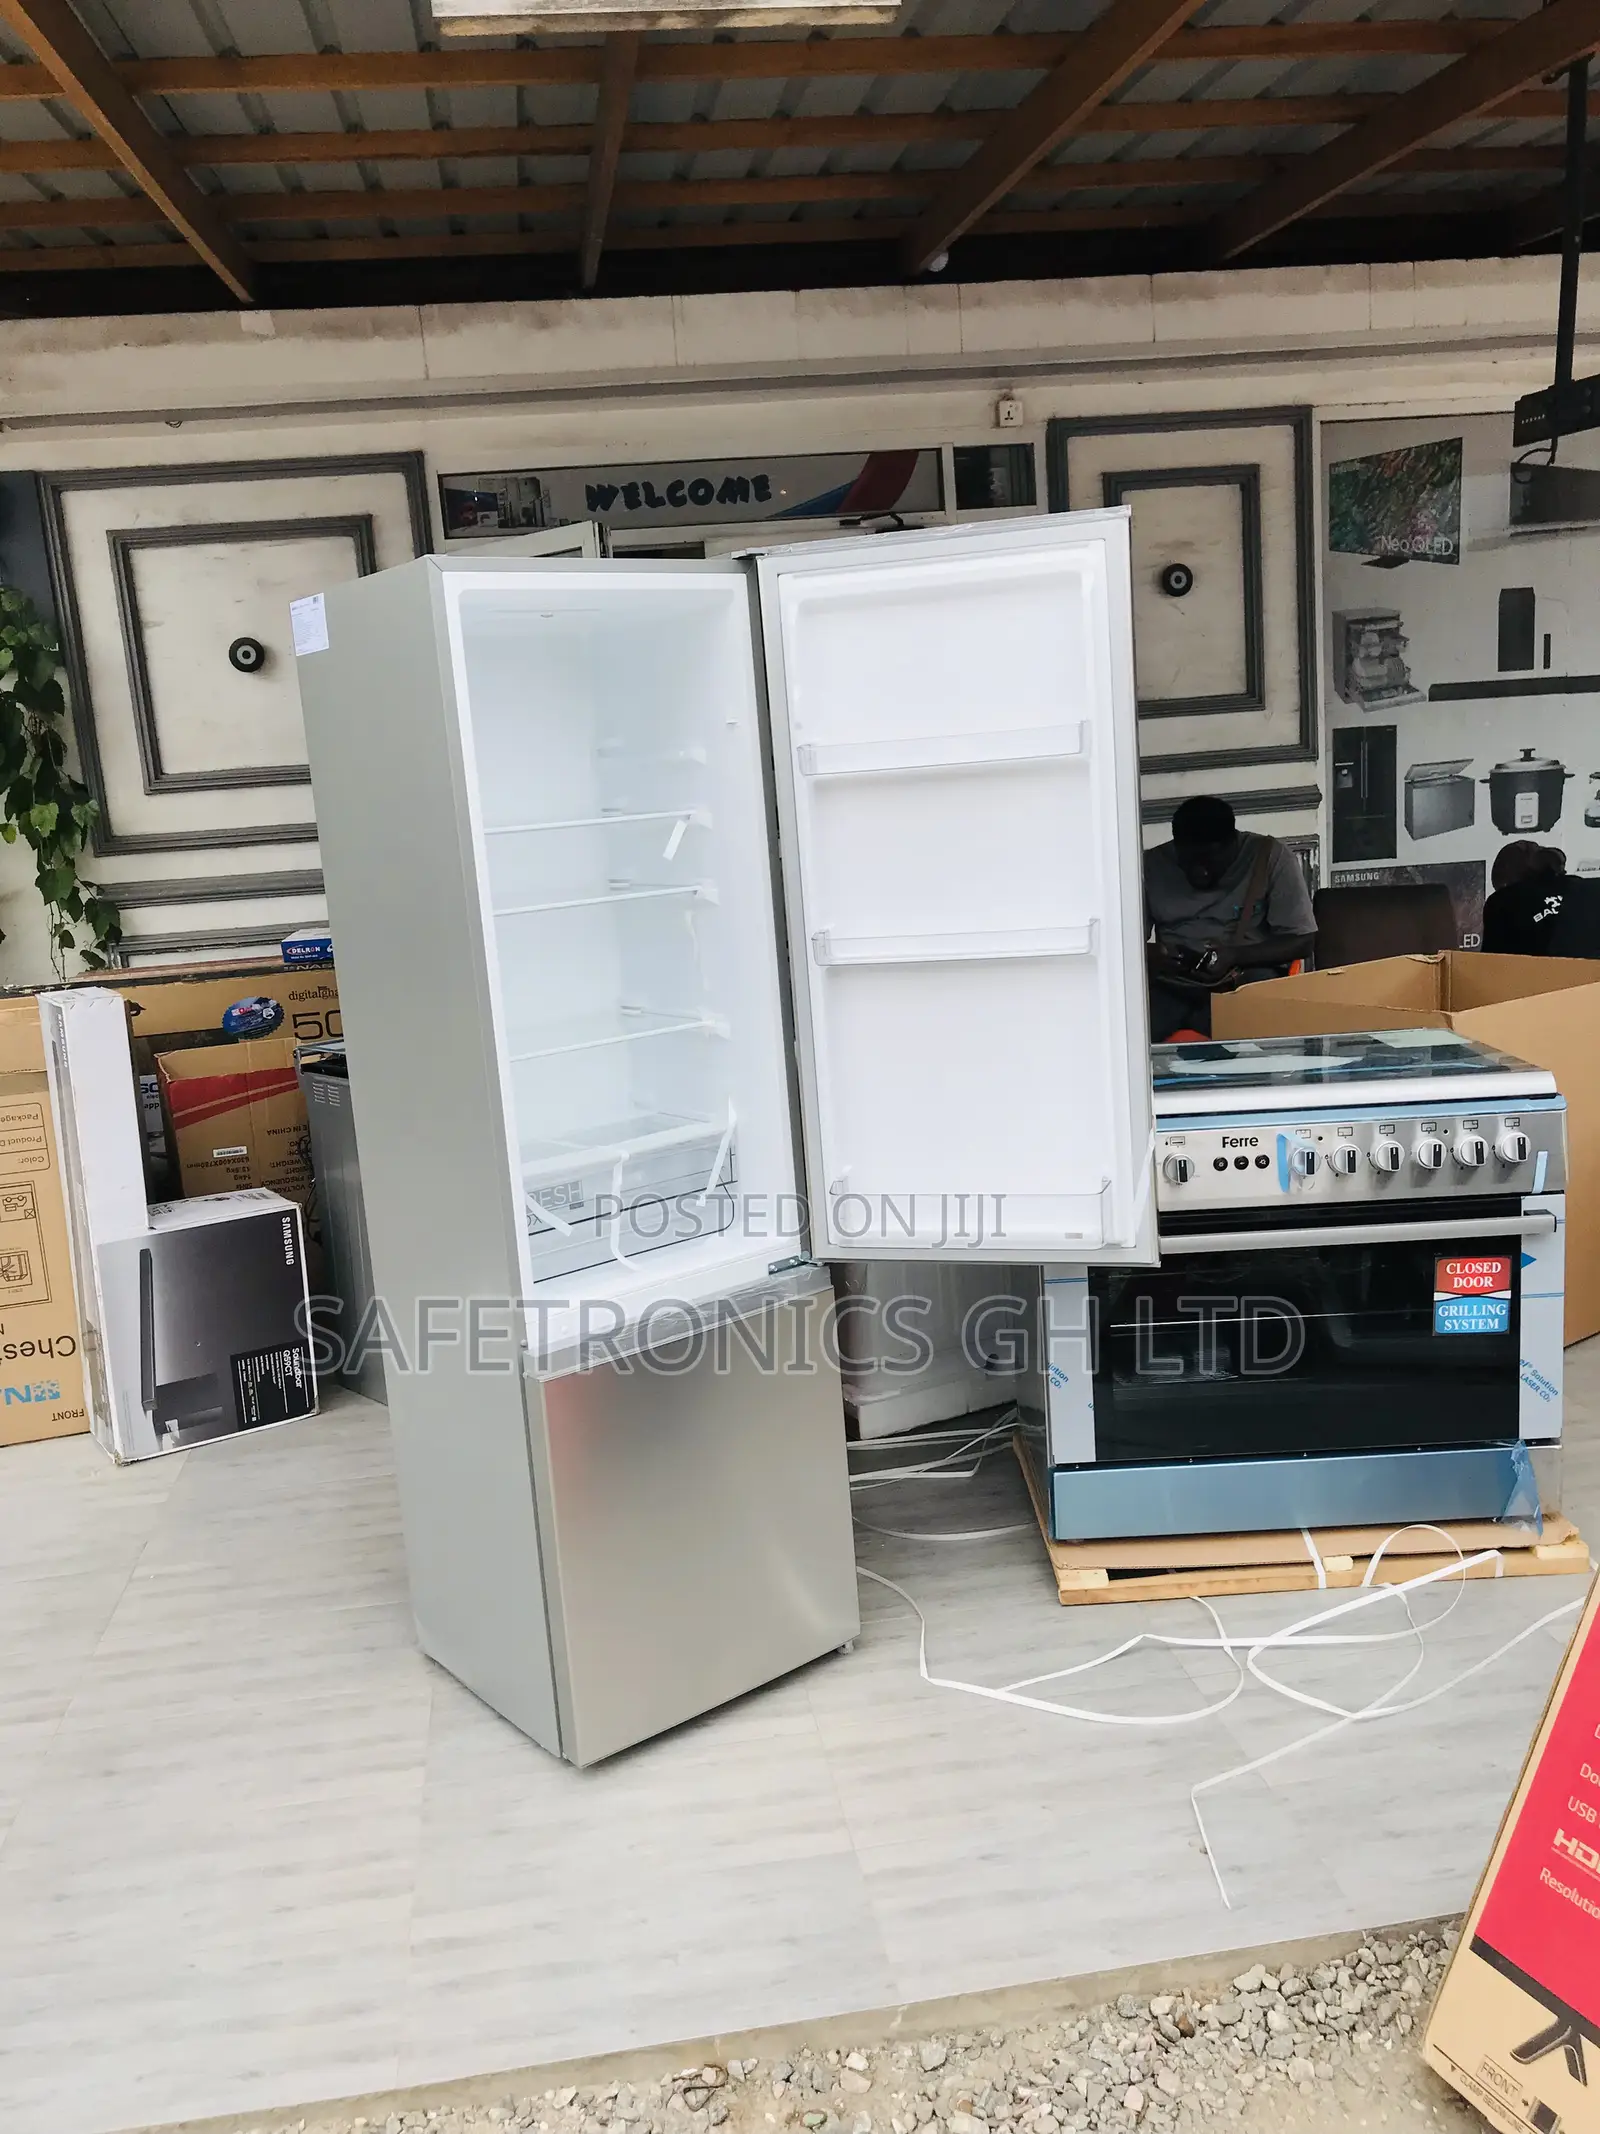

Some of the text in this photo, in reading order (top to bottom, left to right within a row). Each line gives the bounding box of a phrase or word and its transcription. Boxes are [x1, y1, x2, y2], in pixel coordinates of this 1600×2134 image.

[585, 474, 772, 512] WELCOME
[1334, 872, 1381, 883] SAMSUNG
[291, 945, 321, 955] DELRON
[57, 1013, 68, 1068] SAMSUNG
[0, 1113, 39, 1122] Package
[266, 1127, 292, 1136] CHINA
[8, 1136, 42, 1146] Product
[1221, 1136, 1259, 1148] Ferre
[281, 1216, 295, 1266] SAMSUNG
[1446, 1261, 1502, 1275] CLOSED
[1453, 1276, 1494, 1289] DOOR
[1438, 1303, 1507, 1318] GRILLING
[1444, 1318, 1500, 1332] SYSTEM
[283, 1349, 293, 1377] Q59CT
[291, 1347, 303, 1389] Soundbar
[1520, 1372, 1542, 1394] LASER
[1530, 1369, 1559, 1396] Solution
[52, 1408, 85, 1421] FRONT
[1568, 1795, 1598, 1824] USB
[1459, 2074, 1484, 2098] CLAMP
[1480, 2060, 1519, 2098] FRONT
